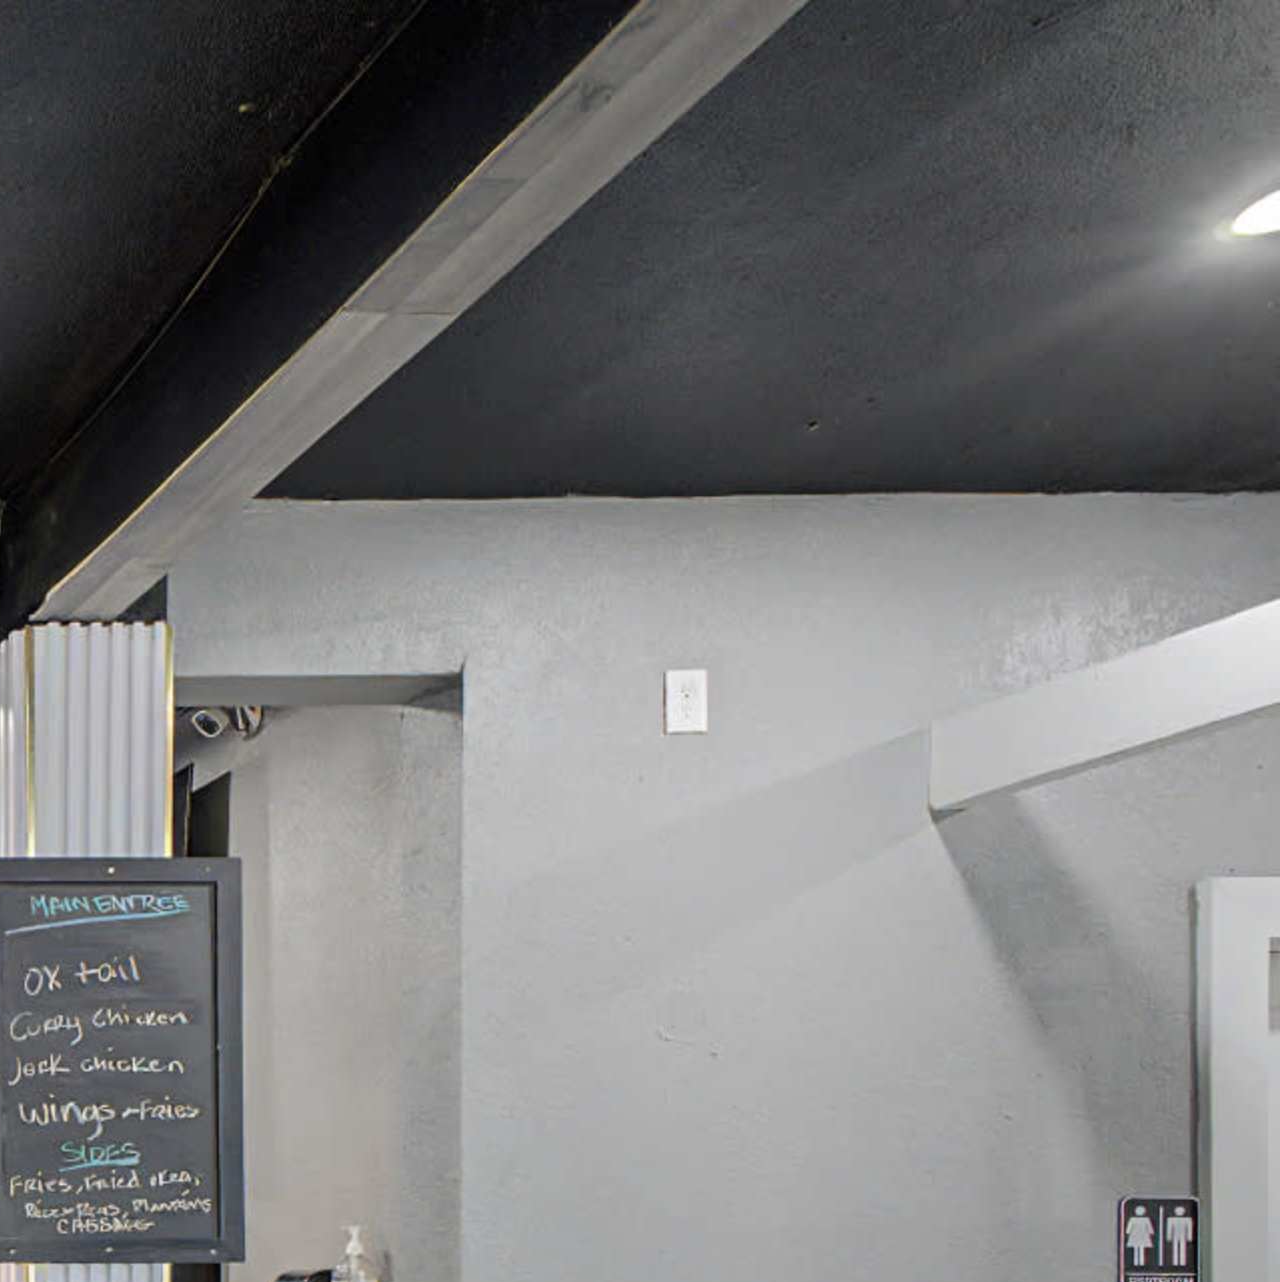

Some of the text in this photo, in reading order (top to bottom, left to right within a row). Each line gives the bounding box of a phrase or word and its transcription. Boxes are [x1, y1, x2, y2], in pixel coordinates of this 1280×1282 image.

[30, 895, 90, 918] MAIN
[74, 954, 140, 984] tail
[59, 1141, 140, 1164] SIDES
